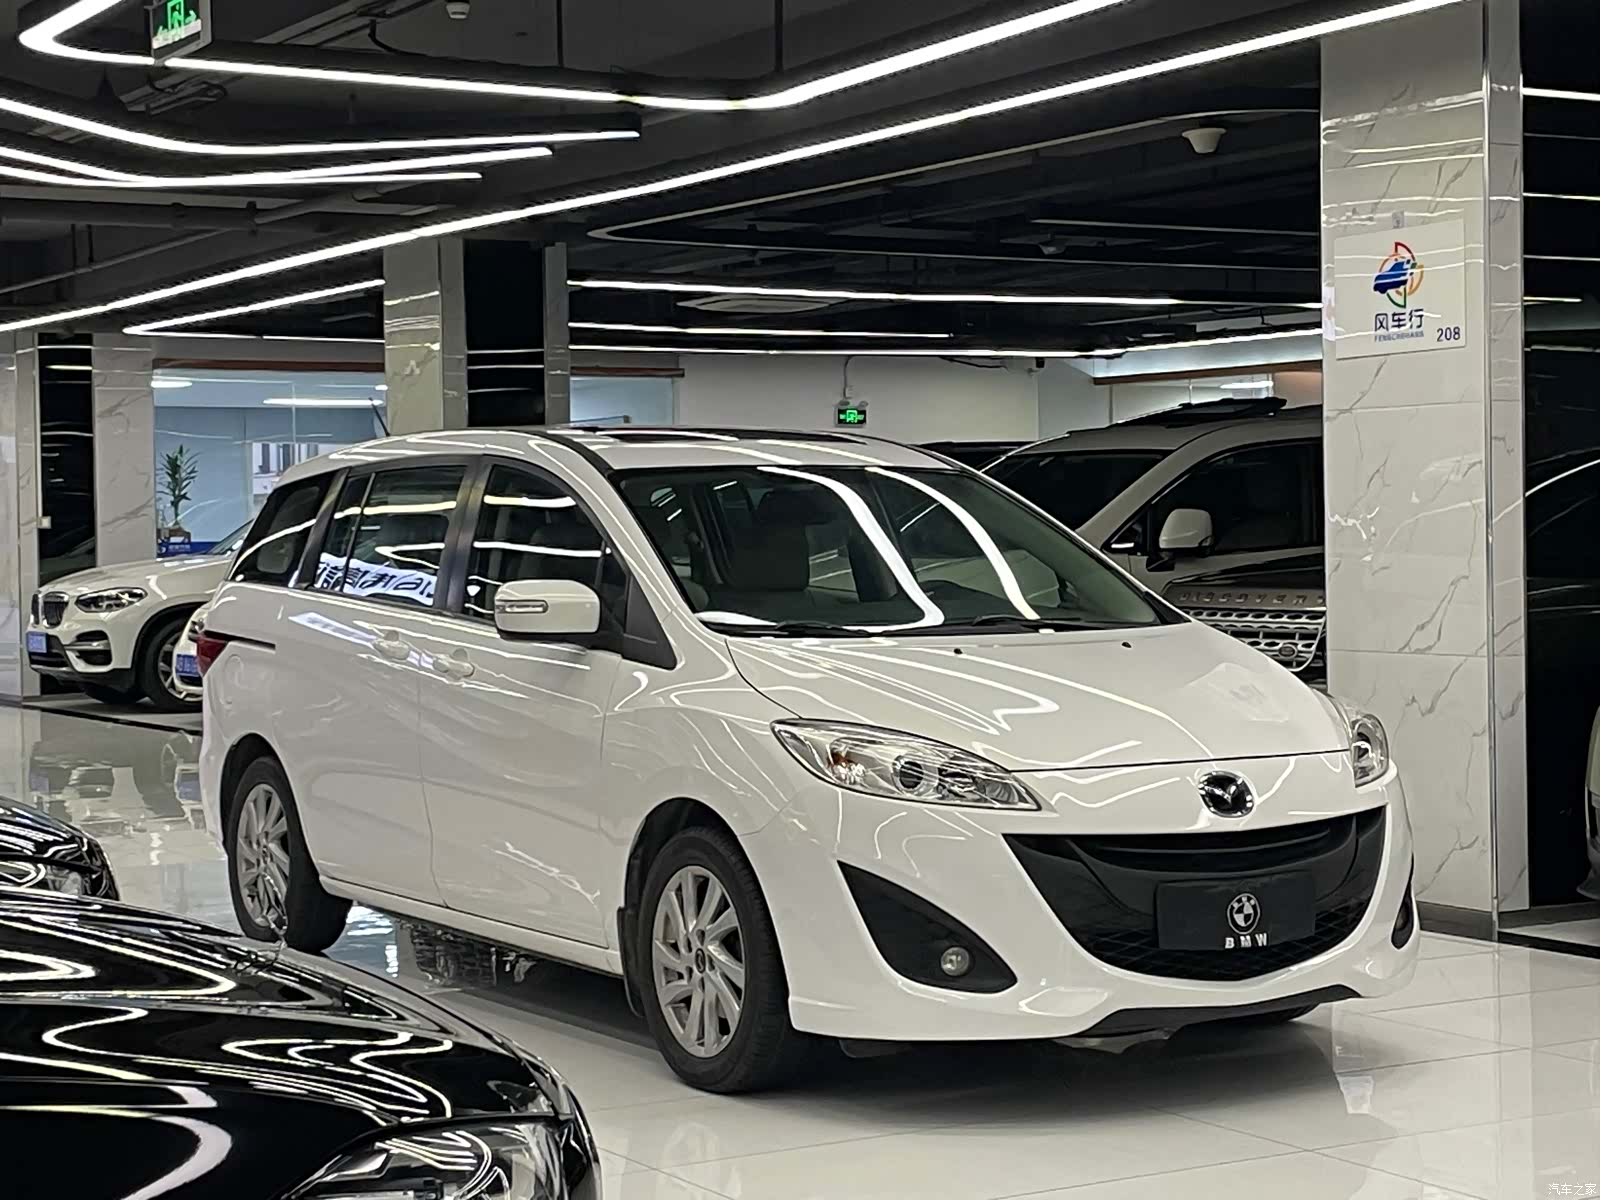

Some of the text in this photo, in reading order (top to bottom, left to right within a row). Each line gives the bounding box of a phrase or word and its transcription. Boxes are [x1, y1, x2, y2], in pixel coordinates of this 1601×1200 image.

[1375, 308, 1424, 331] 风车行
[1436, 326, 1461, 342] 208
[1225, 933, 1267, 949] BMW
